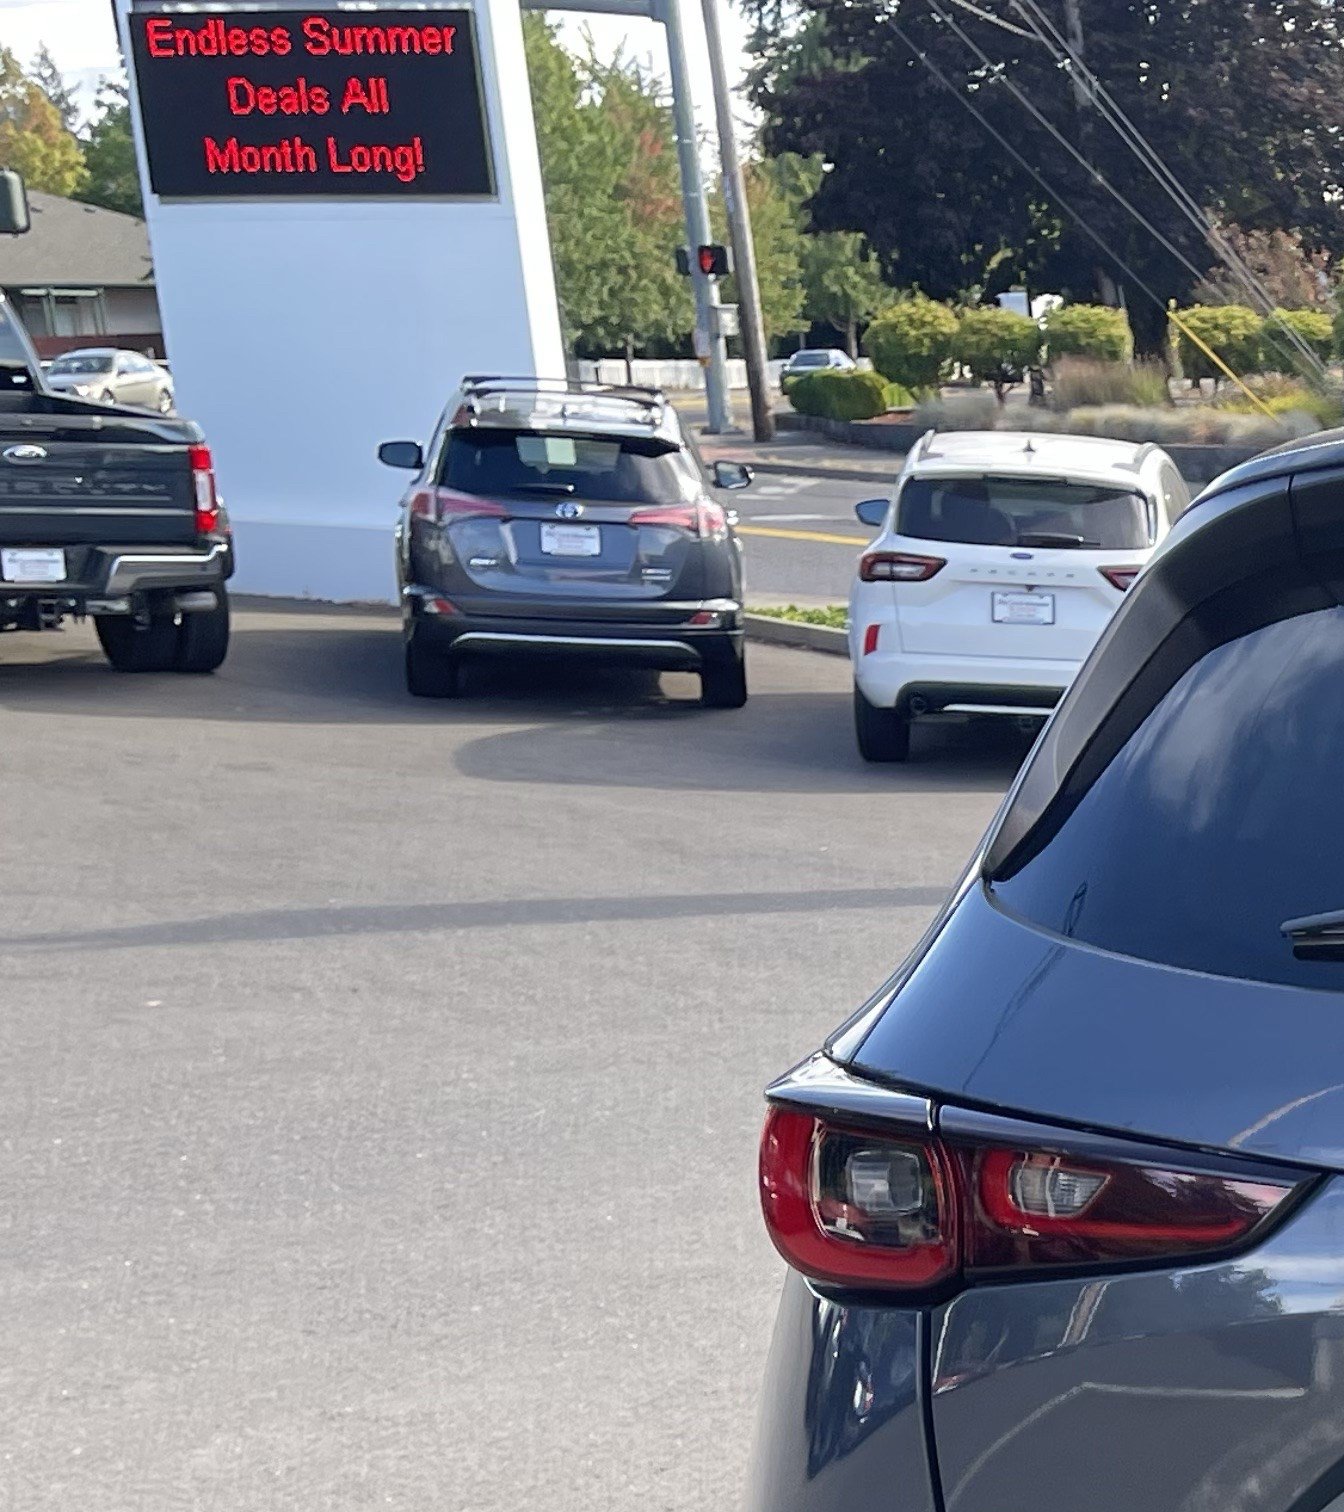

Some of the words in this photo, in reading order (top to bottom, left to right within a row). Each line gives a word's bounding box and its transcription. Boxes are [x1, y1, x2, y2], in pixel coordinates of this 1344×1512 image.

[146, 18, 293, 58] Endless
[302, 16, 457, 56] Summer
[226, 76, 331, 116] Deals
[341, 76, 390, 116] All
[203, 136, 318, 174] Month
[327, 136, 426, 183] Long!
